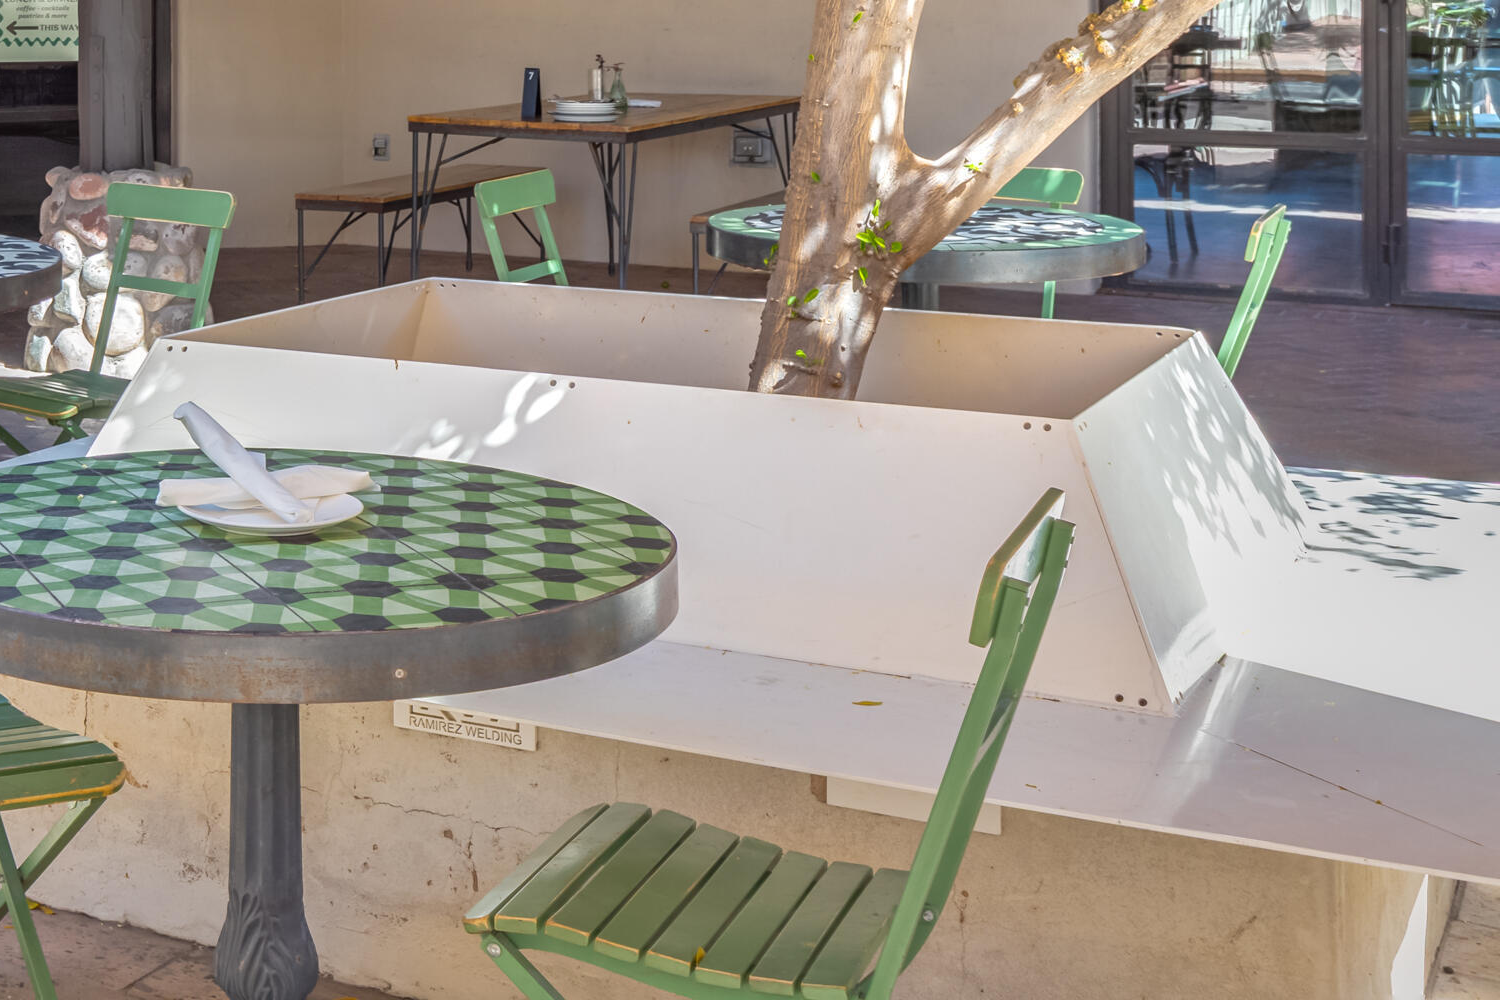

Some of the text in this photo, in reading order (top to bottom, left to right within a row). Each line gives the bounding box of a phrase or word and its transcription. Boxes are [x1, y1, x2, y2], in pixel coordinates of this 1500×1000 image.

[528, 71, 535, 80] 7
[409, 715, 523, 746] RAMIREZ WELDING
